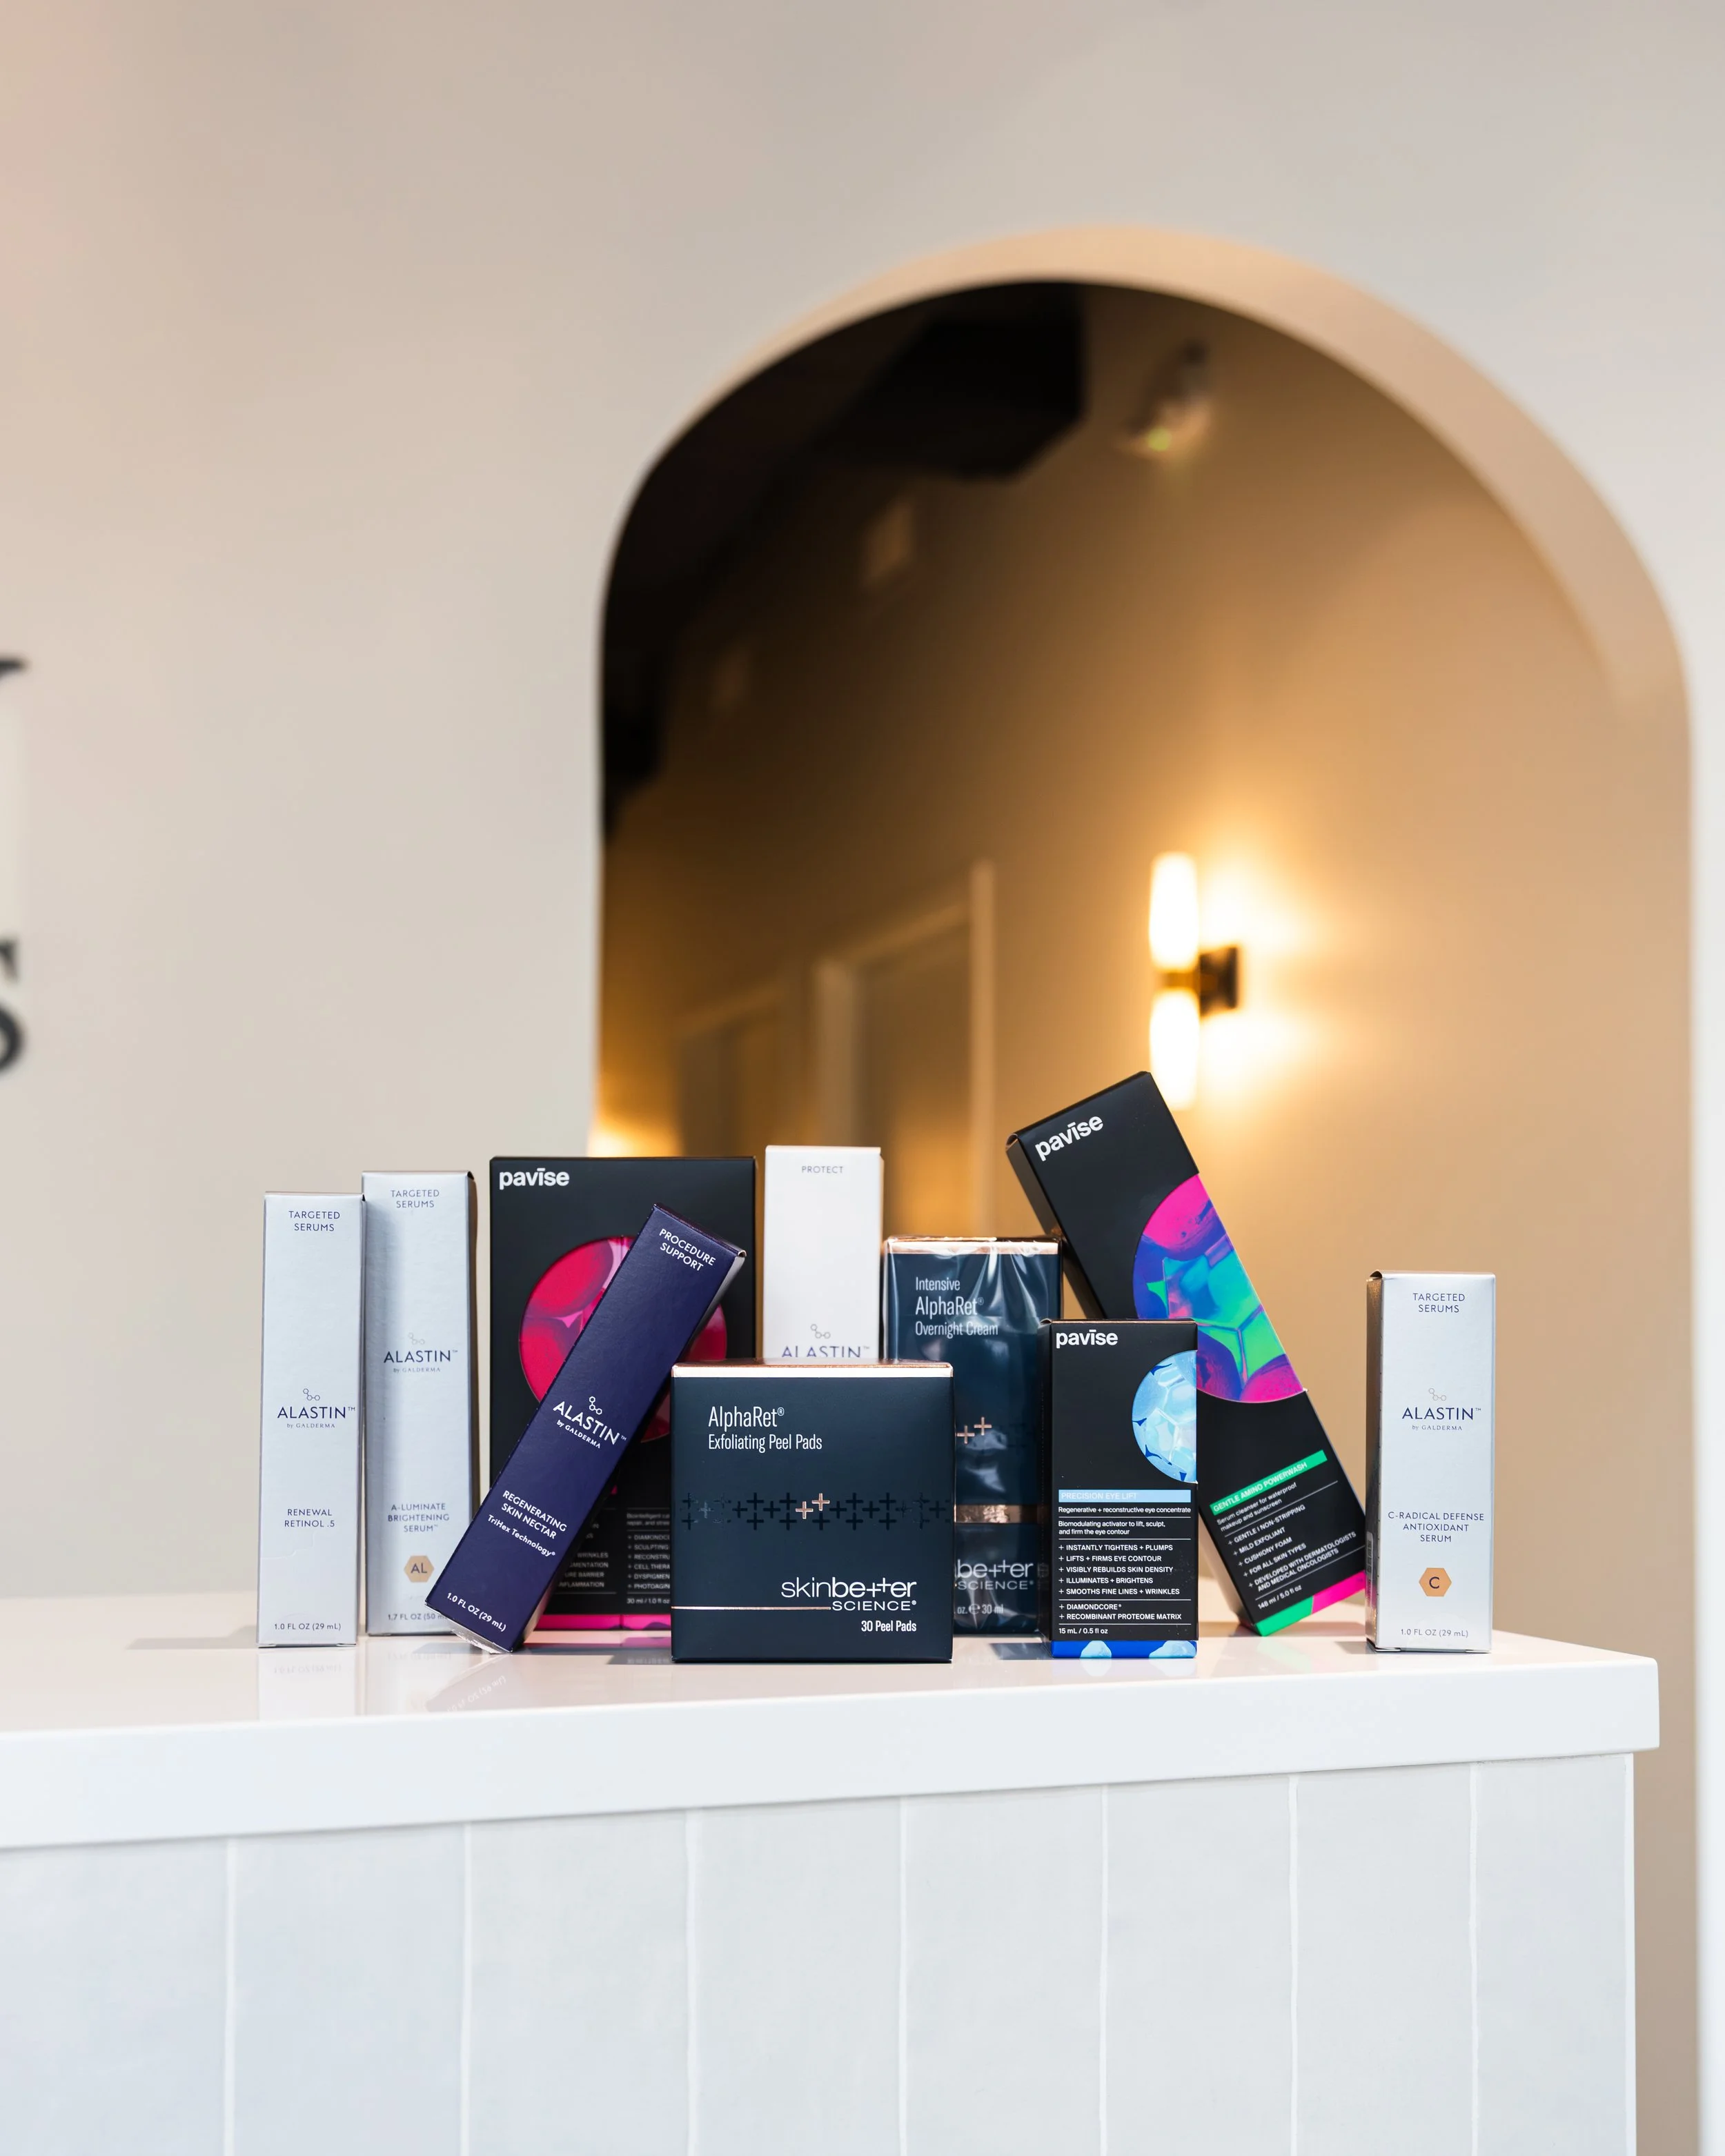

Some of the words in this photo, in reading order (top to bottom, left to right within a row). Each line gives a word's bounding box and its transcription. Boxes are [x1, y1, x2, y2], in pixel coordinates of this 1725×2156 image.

[801, 1165, 843, 1174] PROTECT
[391, 1189, 440, 1197] TARGETED
[396, 1200, 434, 1208] SERUMS
[288, 1210, 339, 1219] TARGETED
[294, 1223, 334, 1232] SERUMS
[659, 1228, 716, 1265] PROCEDURE
[660, 1242, 704, 1271] SUPPORT
[916, 1276, 960, 1291] Intensive
[1412, 1292, 1465, 1301] TARGETED
[1418, 1304, 1459, 1313] SERUMS
[916, 1321, 963, 1338] Overnight
[965, 1321, 998, 1336] Cream
[556, 1419, 564, 1427] by
[564, 1425, 600, 1448] GALDERMA
[709, 1433, 765, 1453] Exfoliating
[769, 1434, 791, 1450] Peel
[796, 1434, 822, 1450] Pads
[1213, 1494, 1239, 1511] GENTLE
[1241, 1483, 1263, 1499] AMINO
[1263, 1462, 1307, 1487] POWERWASH
[390, 1503, 445, 1512] A-LUMINATE
[502, 1490, 566, 1532] REGENERATING
[1216, 1513, 1235, 1525] Serum
[1235, 1501, 1259, 1516] cleanser
[1268, 1481, 1297, 1500] waterproof
[386, 1513, 449, 1523] BRIGHTENING
[488, 1514, 511, 1532] TriHex
[501, 1503, 522, 1519] SKIN
[522, 1514, 556, 1539] NECTAR
[1220, 1518, 1243, 1532] makeup
[1243, 1512, 1254, 1521] and
[1253, 1499, 1282, 1515] sunscreen
[1234, 1527, 1256, 1543] GENTLE
[1259, 1504, 1305, 1530] NON-STRIPPING
[1388, 1511, 1440, 1519] C-RADICAL
[1443, 1512, 1483, 1521] DEFENSE
[1403, 1523, 1468, 1531] ANTIOXIDANT
[1239, 1542, 1254, 1553] MILD
[1254, 1526, 1285, 1546] EXFOLIANT
[1420, 1534, 1451, 1542] SERUM
[1244, 1545, 1274, 1563] CUSHIONY
[1274, 1536, 1292, 1549] FOAM
[1249, 1564, 1262, 1574] FOR
[1262, 1559, 1274, 1568] ALL
[1273, 1552, 1288, 1563] SKIN
[1287, 1543, 1306, 1555] TYPES
[1254, 1565, 1288, 1585] DEVELOPED
[1288, 1557, 1303, 1567] WITH
[1303, 1532, 1356, 1561] DERMATOLOGISTS
[411, 1562, 427, 1573] AL
[1258, 1581, 1270, 1591] AND
[1270, 1569, 1297, 1585] MEDICAL
[1297, 1548, 1339, 1572] ONCOLOGISTS
[1429, 1576, 1439, 1589] C
[1257, 1600, 1268, 1609] 148
[1279, 1590, 1290, 1599] 5.0
[387, 1612, 397, 1621] 1.7
[423, 1612, 437, 1621] (50
[446, 1592, 457, 1602] 1.0
[457, 1599, 466, 1608] FL
[467, 1605, 480, 1615] OZ
[478, 1611, 492, 1621] (29
[491, 1620, 506, 1632] mL)
[312, 1623, 324, 1631] (29
[860, 1620, 873, 1632] 30
[875, 1620, 893, 1632] Peel
[896, 1620, 916, 1632] Pads
[1439, 1629, 1451, 1637] (29
[1454, 1630, 1468, 1638] mL)
